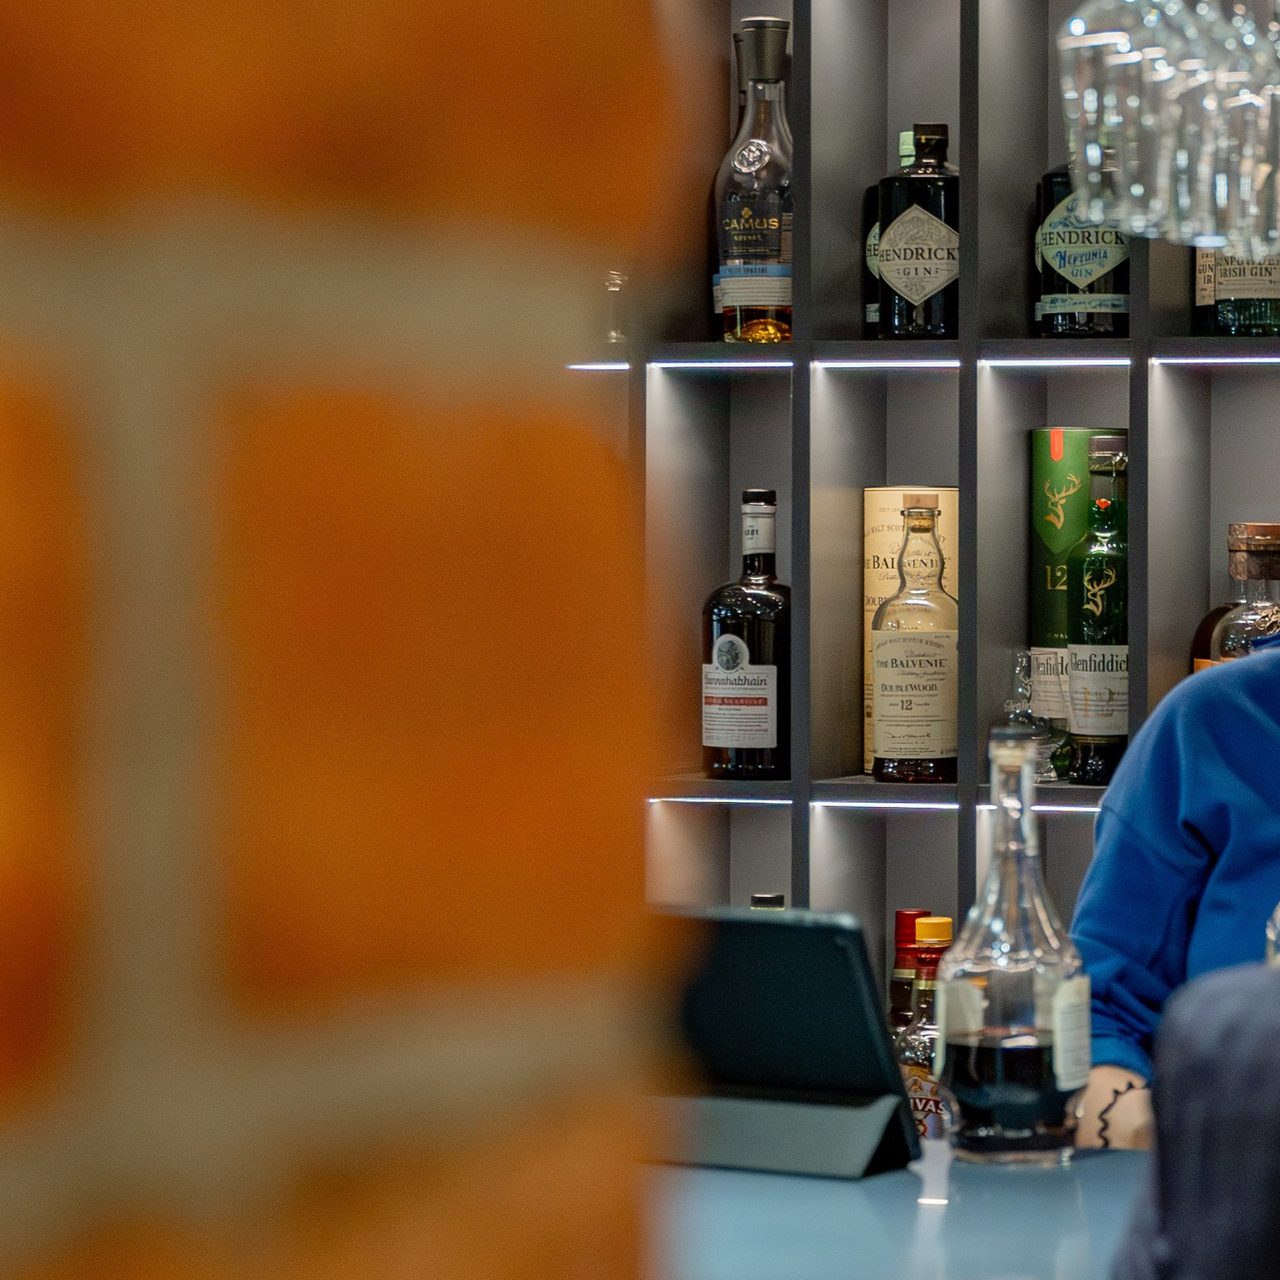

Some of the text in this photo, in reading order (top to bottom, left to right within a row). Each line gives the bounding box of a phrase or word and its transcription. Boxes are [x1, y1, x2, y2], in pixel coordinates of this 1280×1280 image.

[722, 218, 780, 231] CAMUS
[902, 266, 932, 276] GIN
[1220, 266, 1273, 278] IRISH GIN
[1045, 565, 1068, 590] 12
[890, 658, 946, 669] BALVENIE
[900, 699, 913, 710] 12
